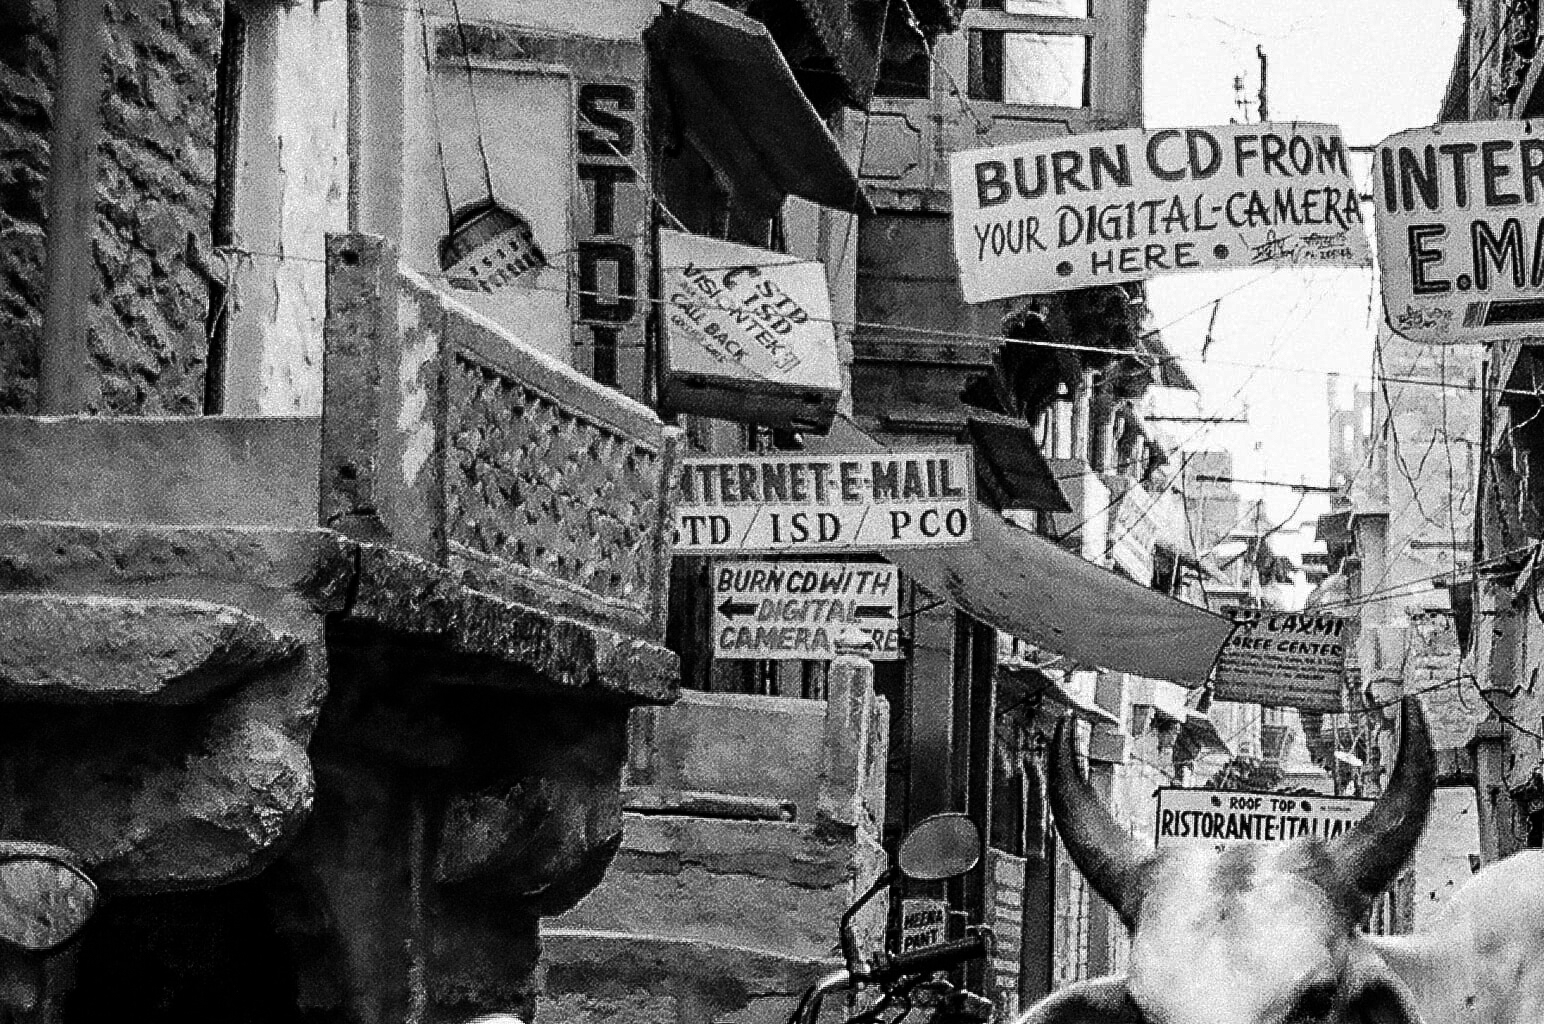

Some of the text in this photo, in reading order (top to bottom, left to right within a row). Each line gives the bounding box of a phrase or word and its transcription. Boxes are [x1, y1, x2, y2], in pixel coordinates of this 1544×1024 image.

[975, 131, 1351, 207] BURN CD FROM
[974, 216, 1047, 260] YOUR
[1056, 189, 1364, 248] DIGITAL-CAMERA
[1092, 242, 1201, 277] HERE
[770, 511, 842, 545] ISD
[889, 508, 968, 540] PCO
[717, 567, 785, 593] BURN
[1229, 796, 1297, 812] ROOF TOP
